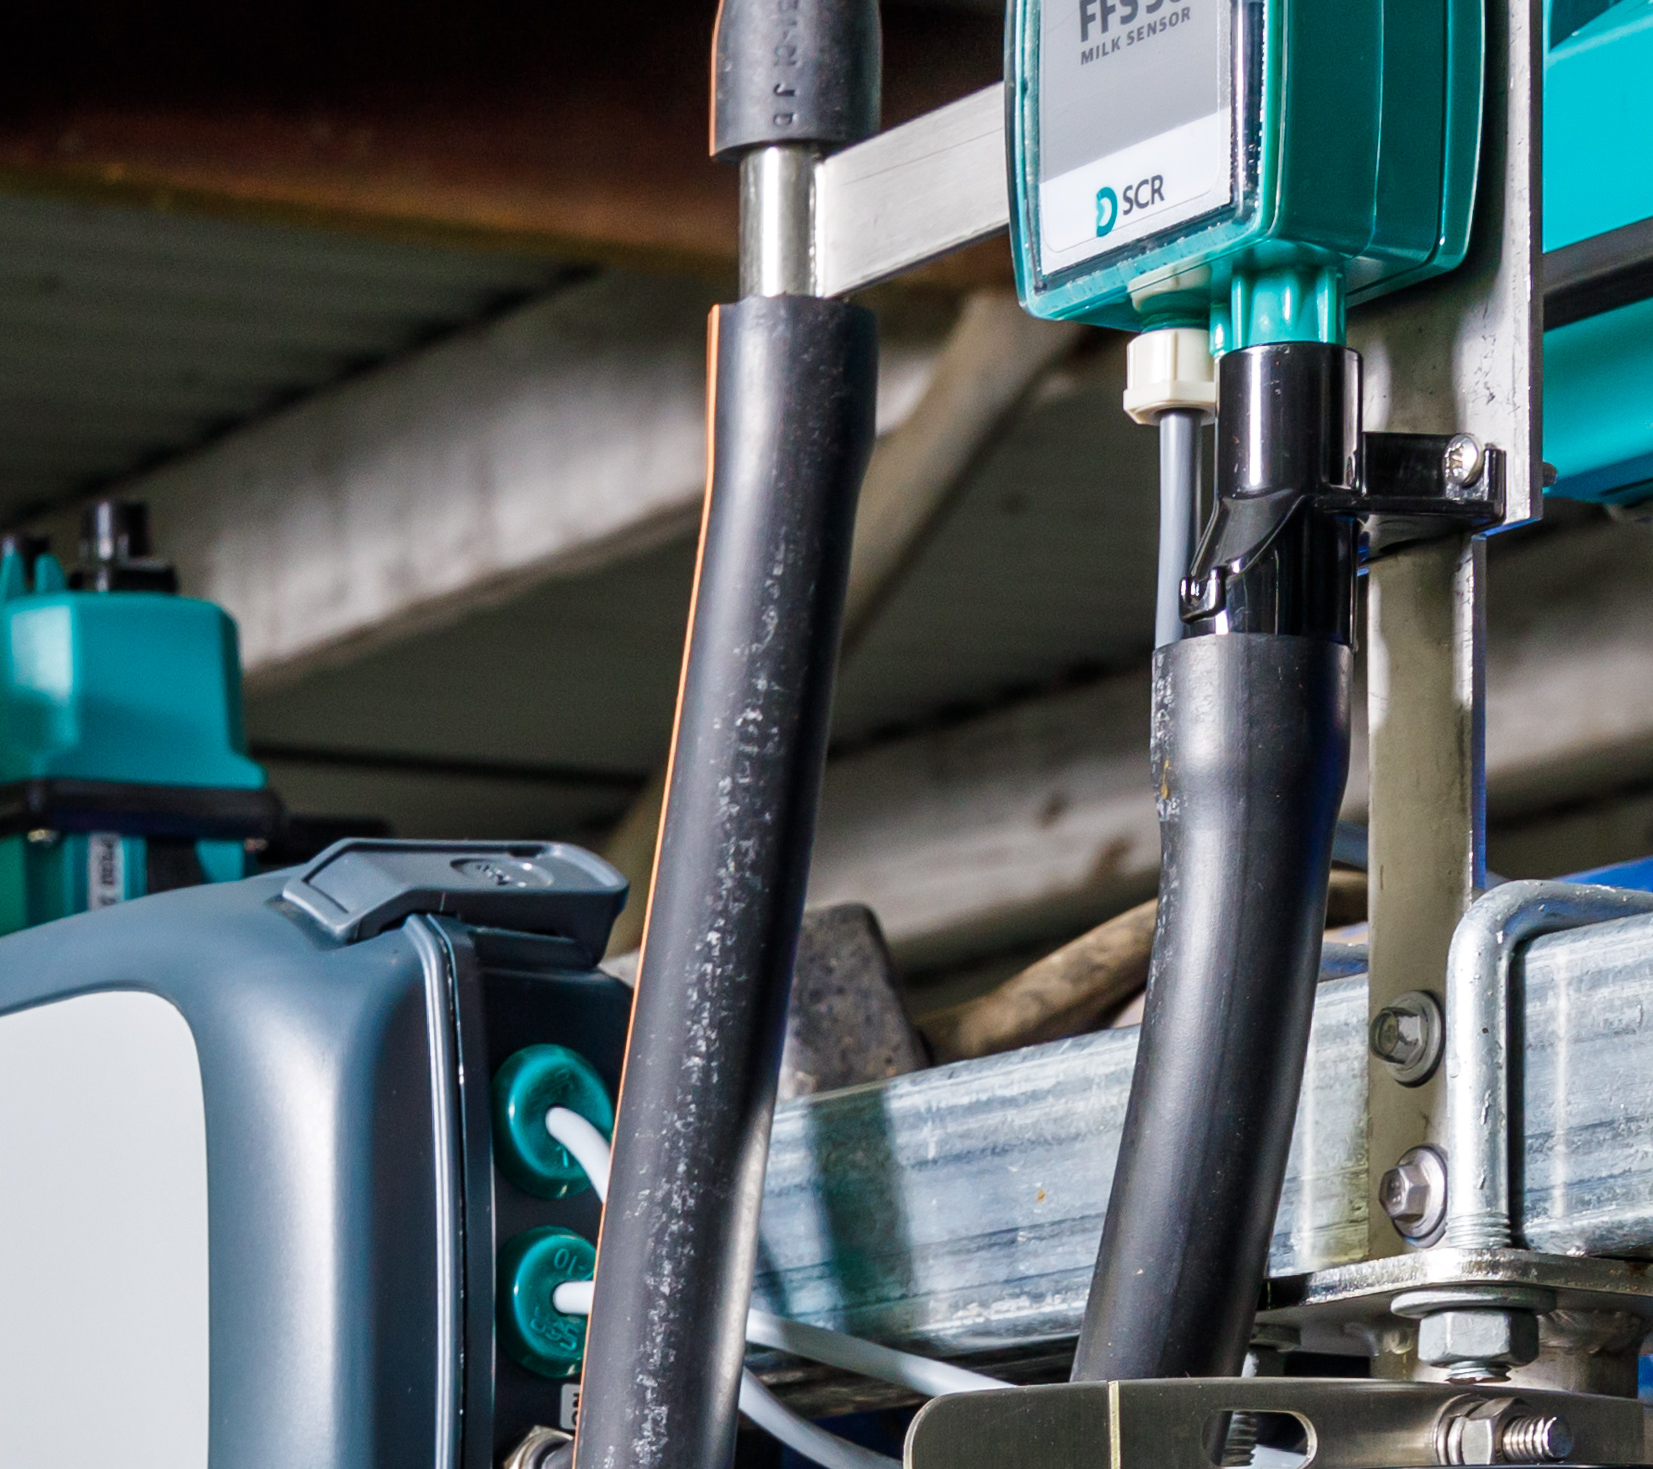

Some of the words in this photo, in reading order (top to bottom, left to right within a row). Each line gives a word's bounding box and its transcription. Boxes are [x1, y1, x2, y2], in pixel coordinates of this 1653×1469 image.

[1081, 36, 1121, 65] MILK
[1126, 7, 1191, 46] SENSOR
[1123, 174, 1165, 215] SCR
